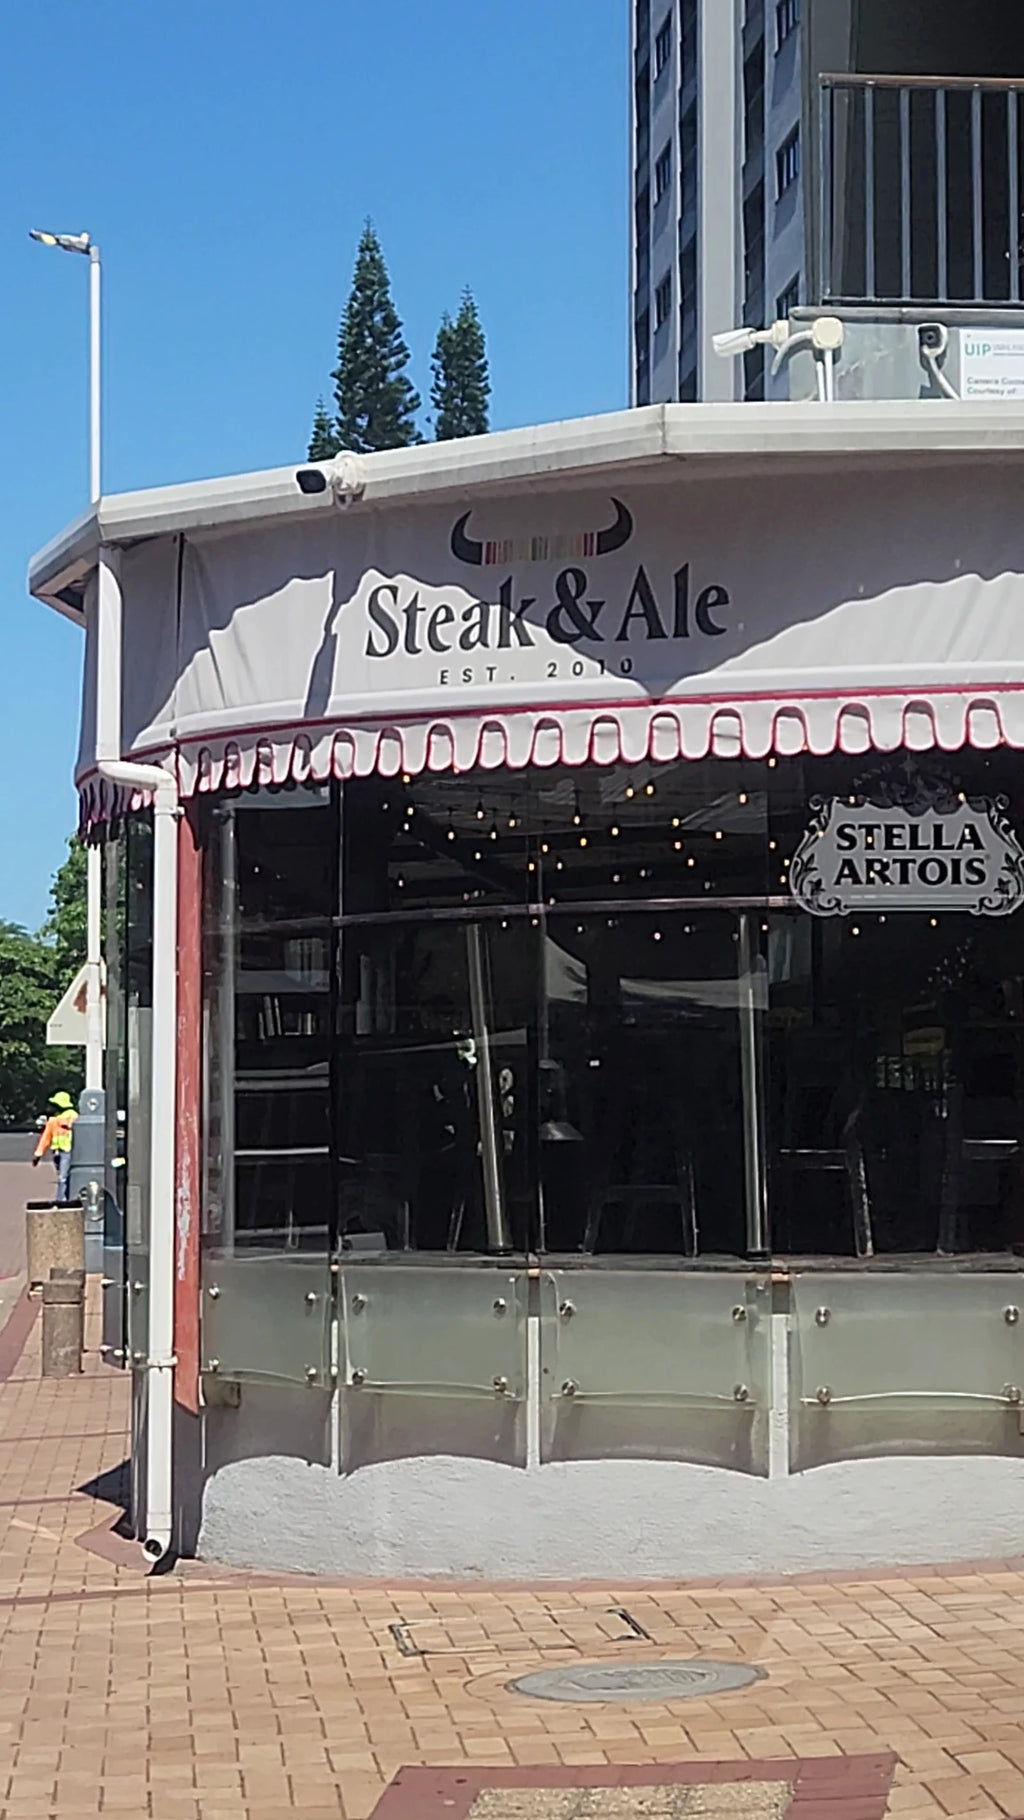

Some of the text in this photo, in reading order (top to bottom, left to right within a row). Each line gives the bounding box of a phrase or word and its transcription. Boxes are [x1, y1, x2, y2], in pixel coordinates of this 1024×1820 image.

[965, 344, 992, 356] UIP
[365, 561, 731, 659] Steak & Ale
[440, 657, 632, 685] EST. 2010
[836, 822, 986, 851] STELLA
[833, 857, 987, 886] ARTOIS
